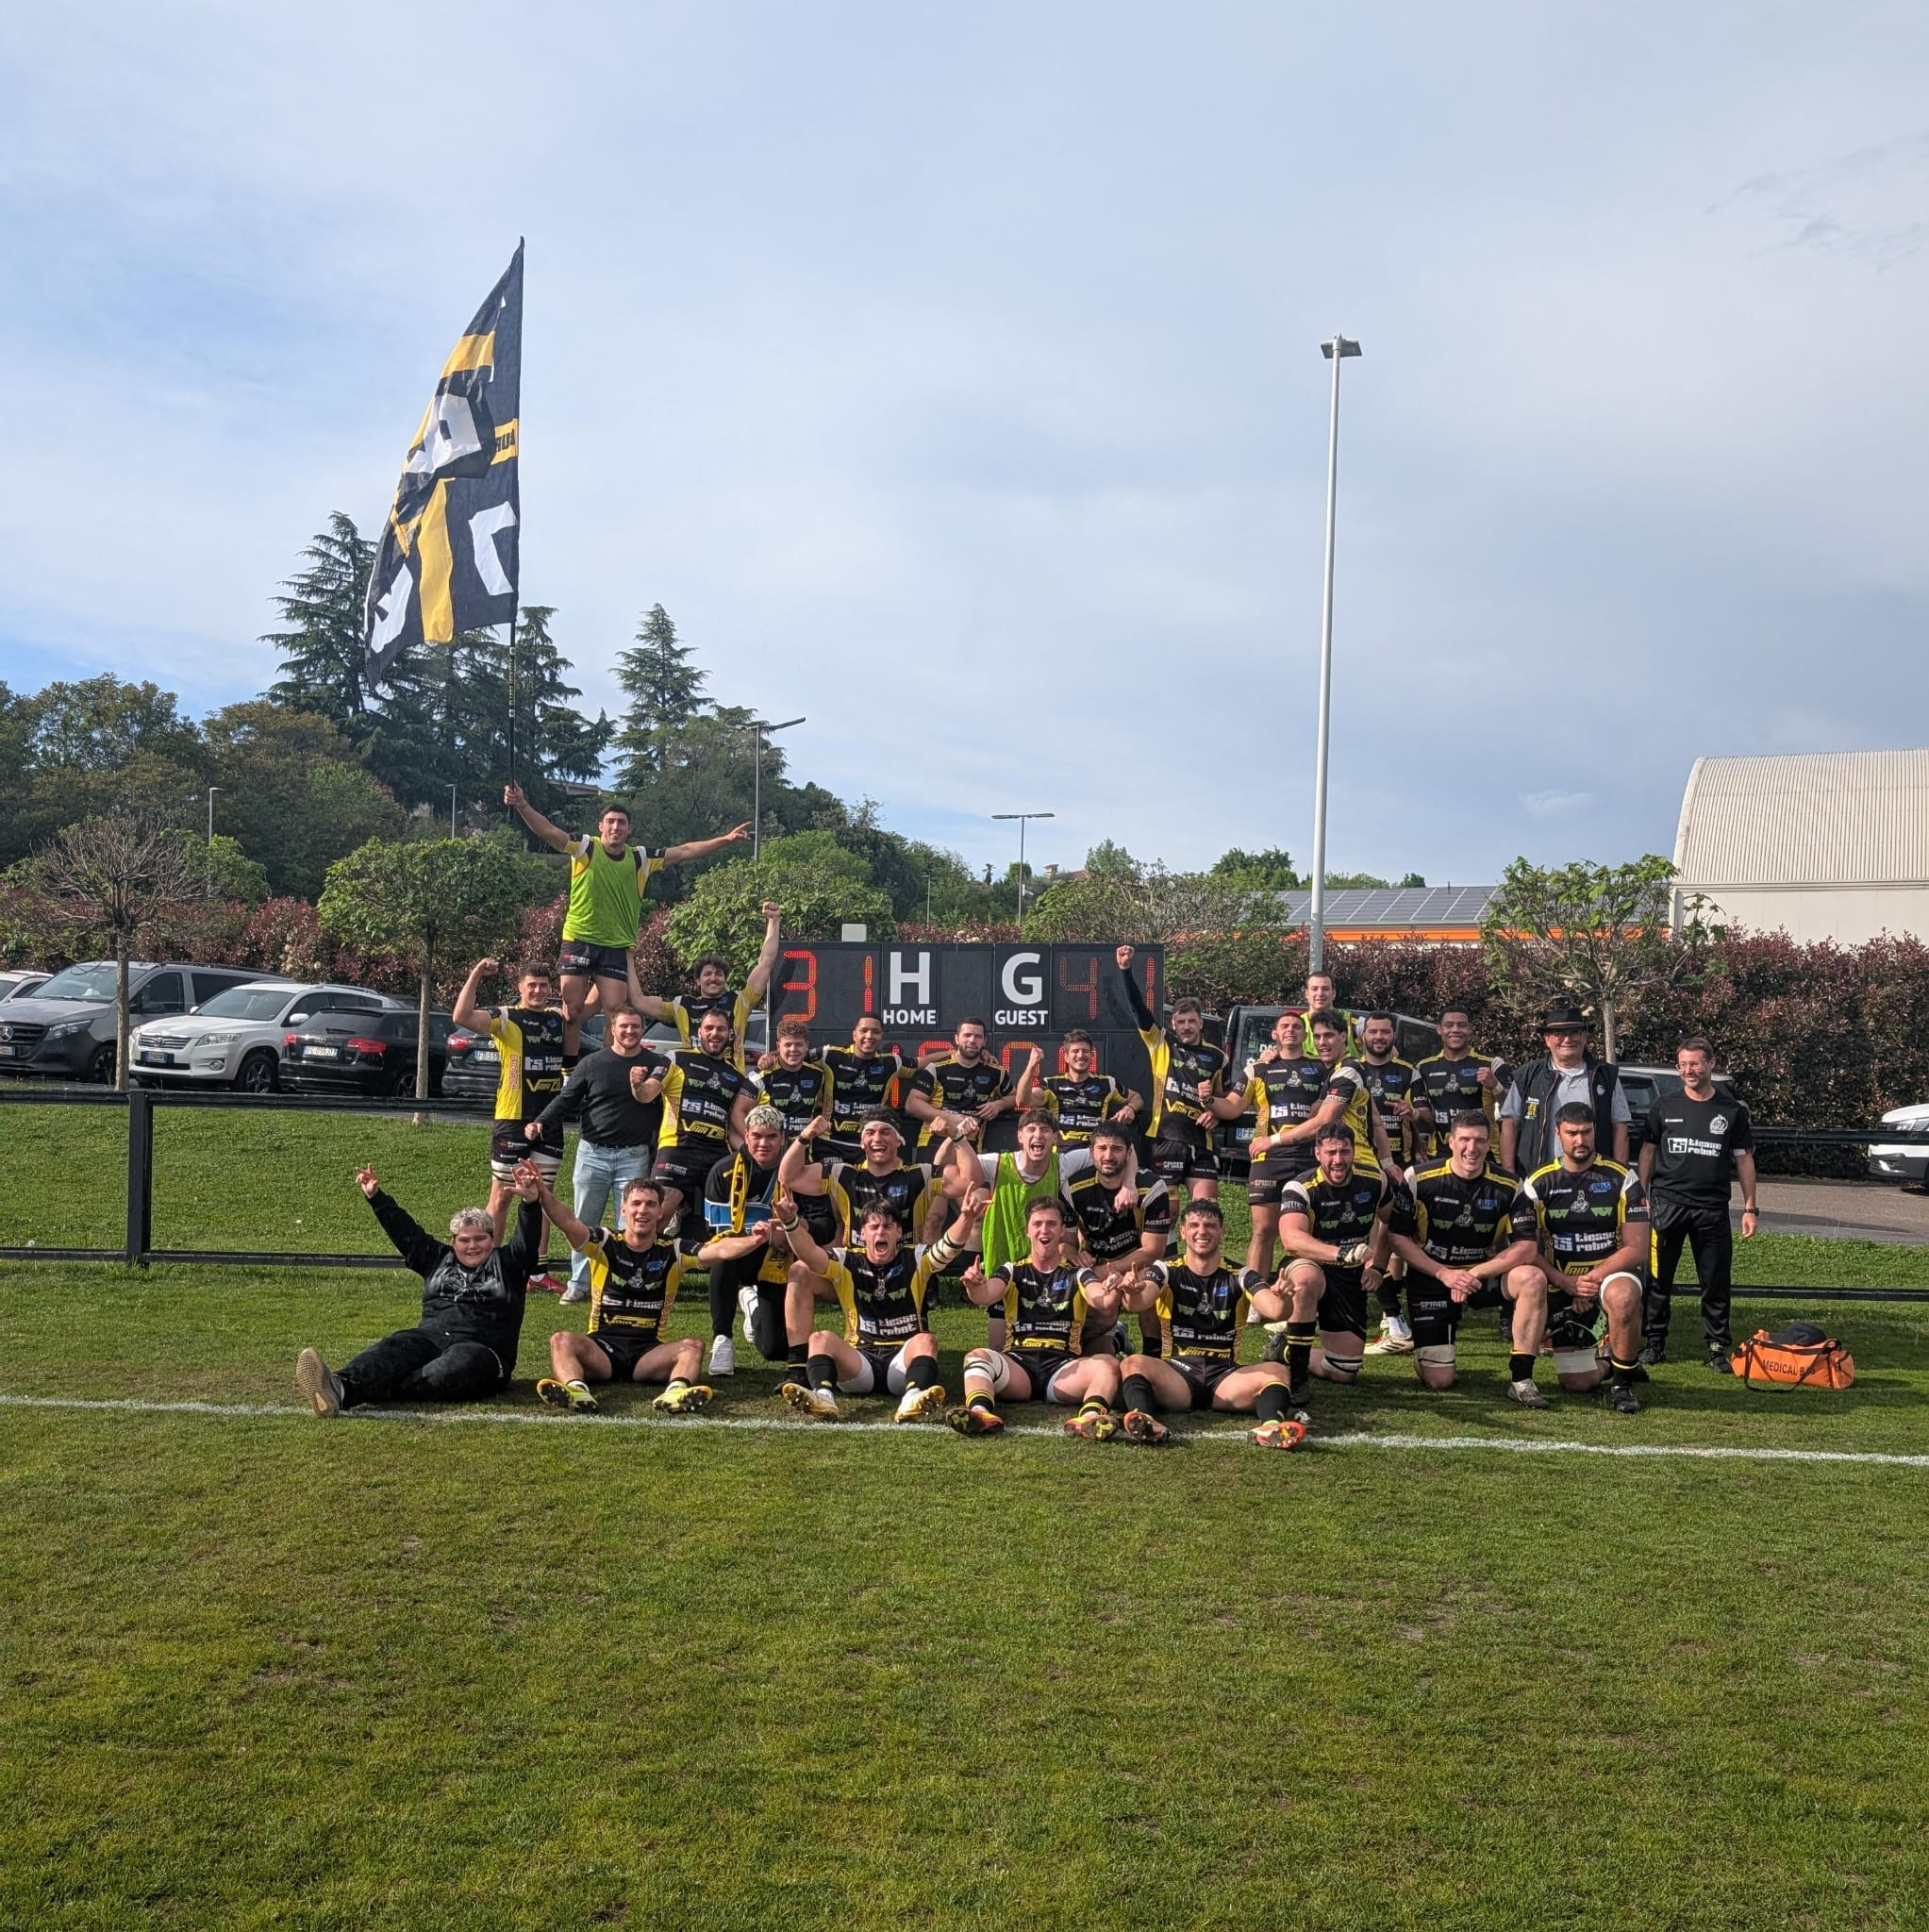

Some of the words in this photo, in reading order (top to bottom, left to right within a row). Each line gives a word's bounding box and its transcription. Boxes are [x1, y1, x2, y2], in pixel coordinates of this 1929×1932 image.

[890, 952, 930, 1005] H
[1002, 952, 1042, 1005] G
[883, 1009, 937, 1025] HOME
[995, 1009, 1049, 1025] GUEST
[1271, 1105, 1289, 1118] ts
[1688, 1138, 1721, 1150] tiesse
[1162, 1160, 1184, 1169] SPIDER
[1420, 1300, 1448, 1308] SPIDER
[1762, 1359, 1798, 1375] MEDICAL
